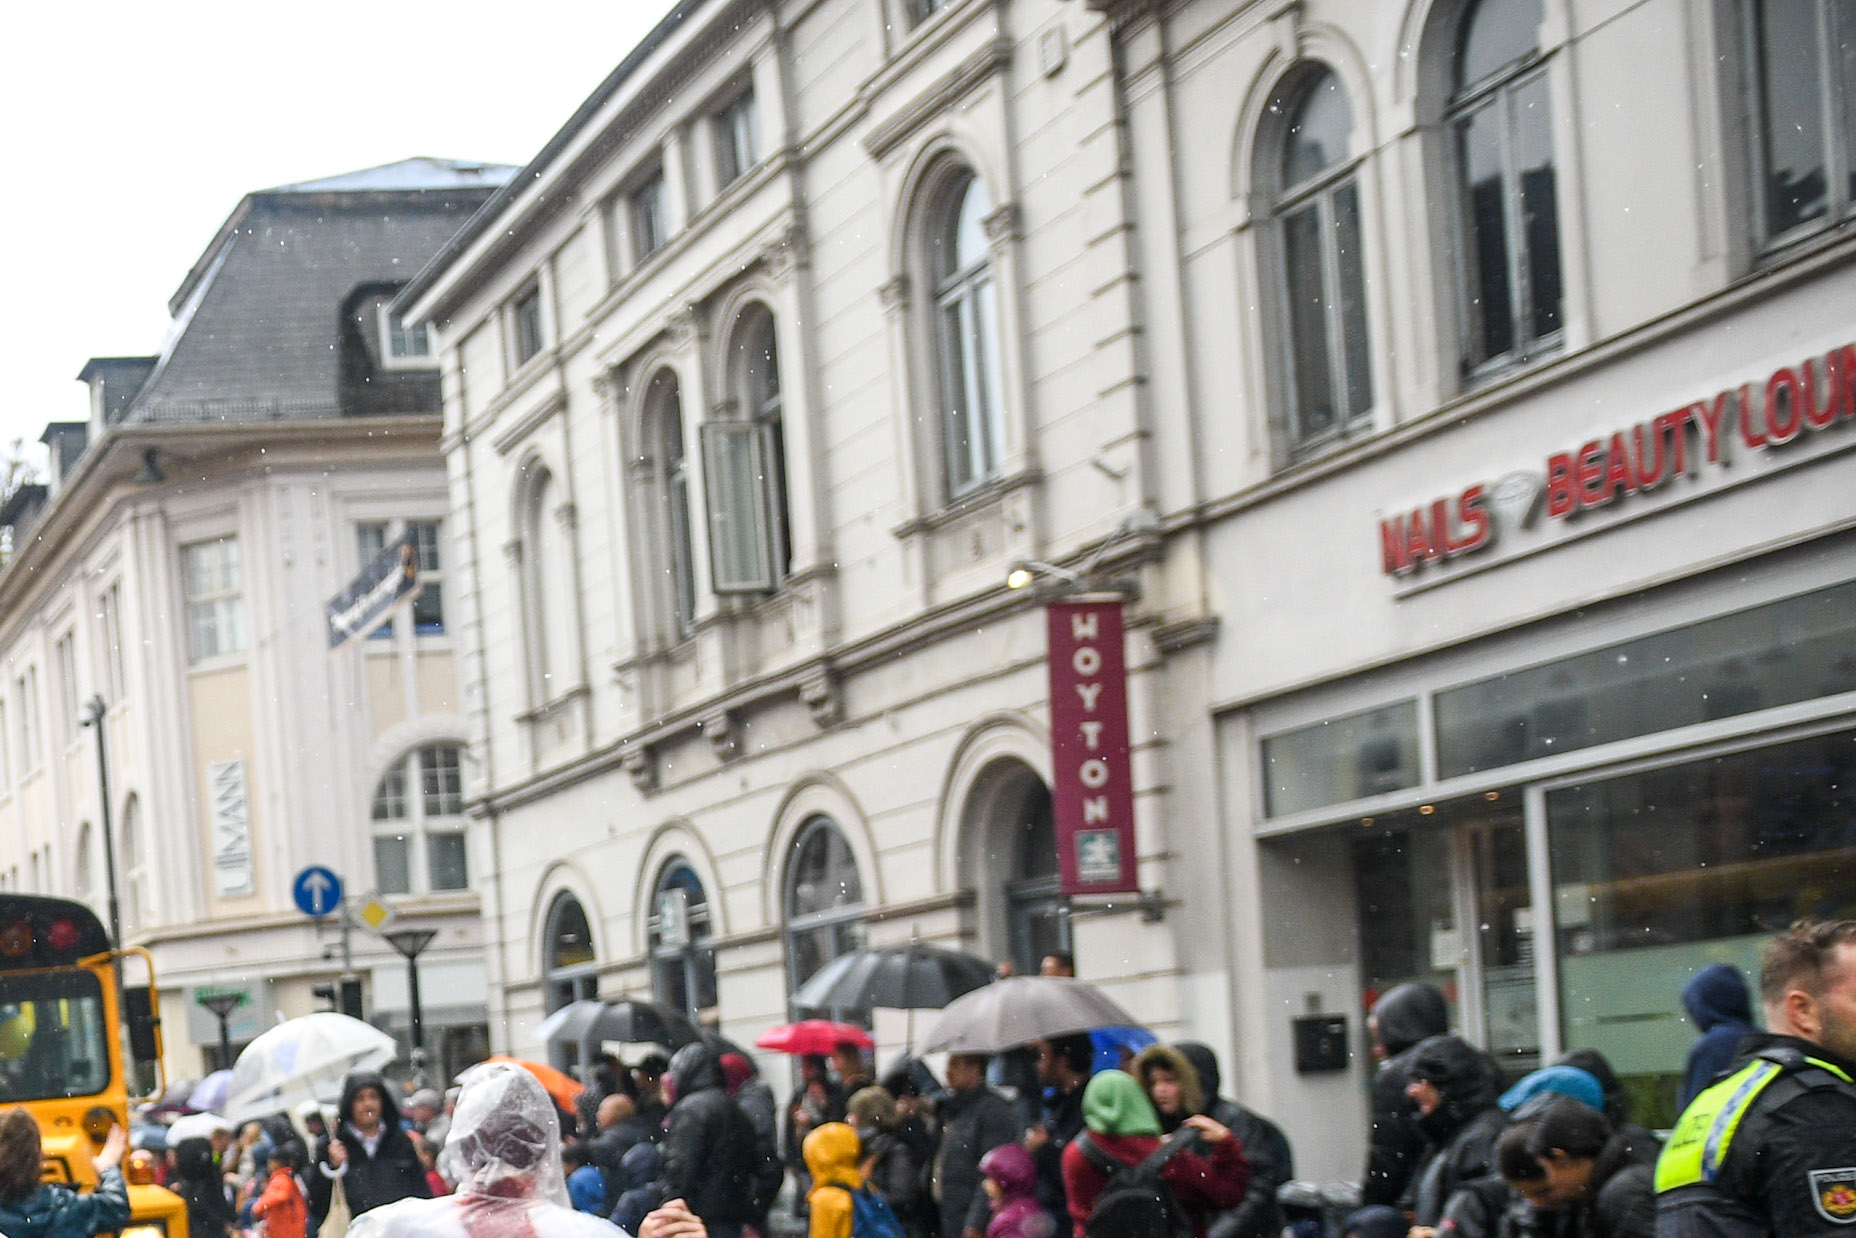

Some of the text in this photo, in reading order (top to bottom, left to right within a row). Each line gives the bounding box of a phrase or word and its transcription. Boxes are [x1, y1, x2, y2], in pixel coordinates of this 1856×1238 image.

[1379, 484, 1490, 576] NAILS
[1546, 391, 1728, 519] BEAUTY
[1070, 611, 1110, 824] HOYTON
